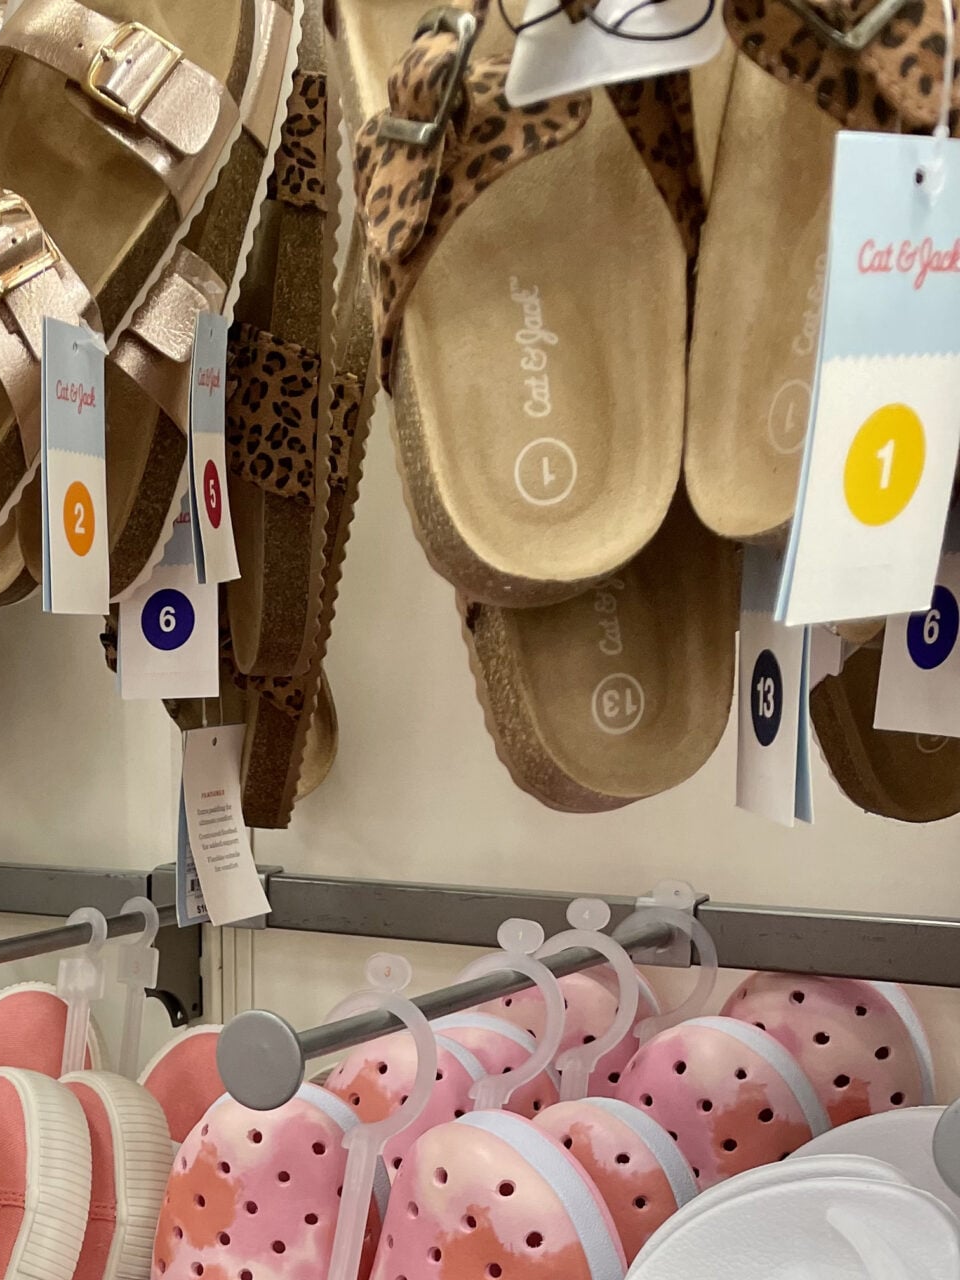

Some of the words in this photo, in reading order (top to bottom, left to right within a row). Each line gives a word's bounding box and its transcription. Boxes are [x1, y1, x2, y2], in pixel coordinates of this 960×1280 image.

[858, 238, 892, 274] Cat
[895, 239, 916, 273] &
[521, 346, 548, 371] &
[56, 379, 70, 401] Cat
[69, 383, 80, 403] &
[77, 382, 97, 415] Jack
[523, 374, 552, 417] Cat
[876, 438, 896, 491] 1
[209, 479, 217, 509] 5
[74, 502, 86, 535] 2
[159, 604, 176, 633] 6
[923, 608, 941, 645] 6
[602, 688, 638, 717] 13
[756, 677, 775, 719] 13
